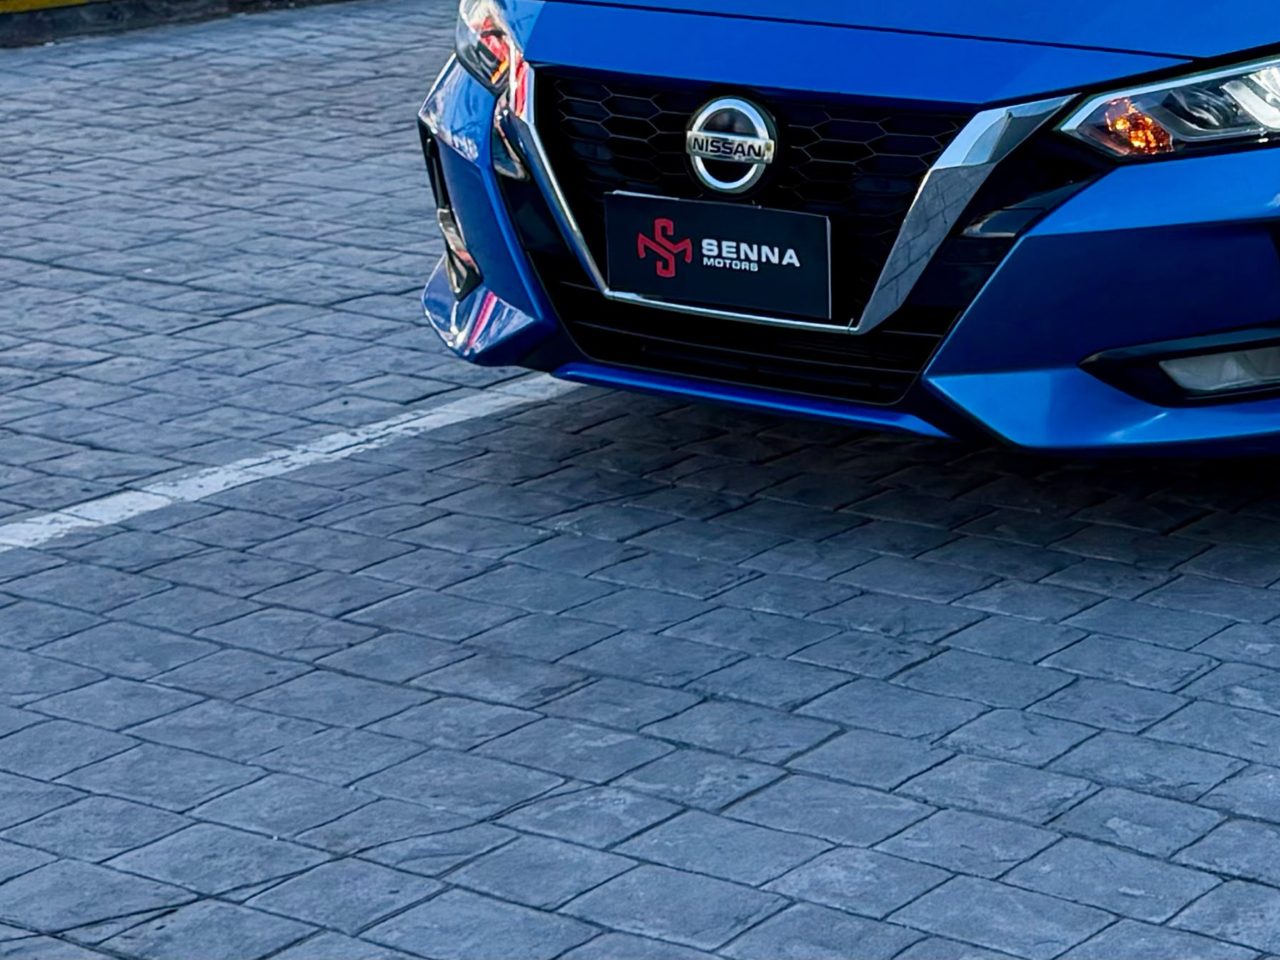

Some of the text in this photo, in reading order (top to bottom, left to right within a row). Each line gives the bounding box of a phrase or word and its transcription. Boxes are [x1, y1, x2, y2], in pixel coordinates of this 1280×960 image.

[693, 137, 762, 158] NISSAN
[702, 238, 800, 267] SENNA
[703, 256, 758, 272] MOTORS
